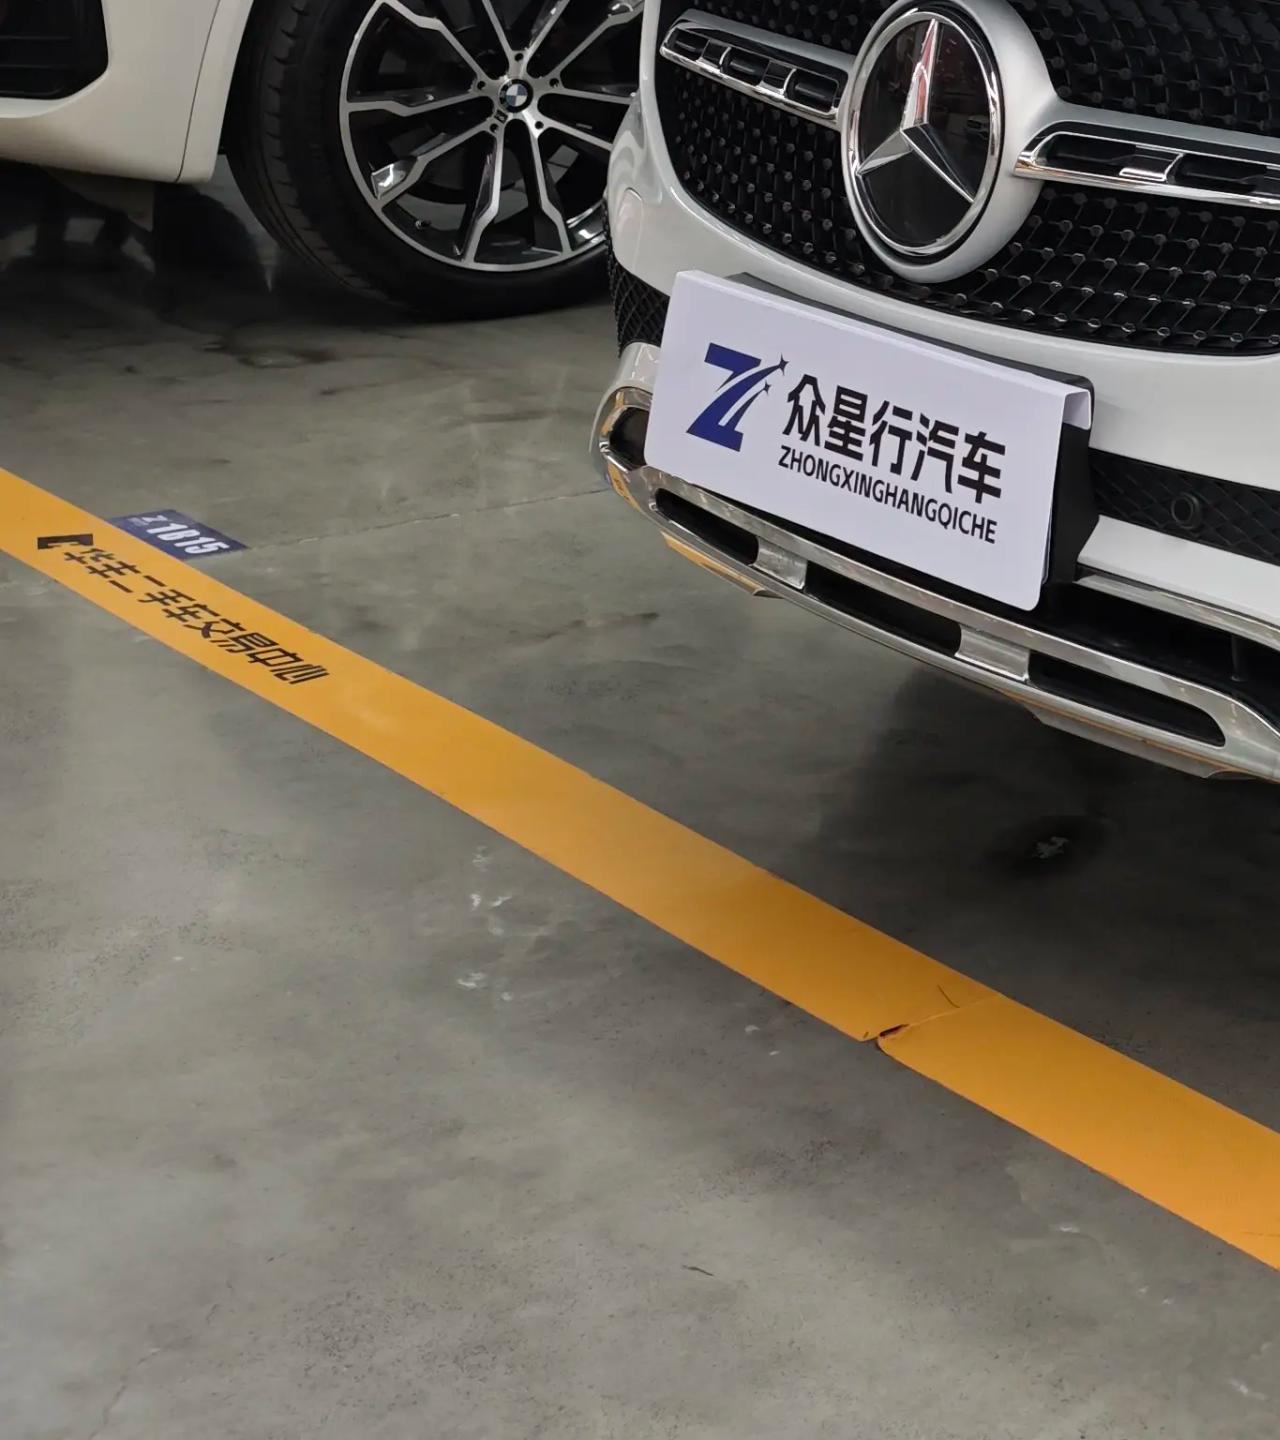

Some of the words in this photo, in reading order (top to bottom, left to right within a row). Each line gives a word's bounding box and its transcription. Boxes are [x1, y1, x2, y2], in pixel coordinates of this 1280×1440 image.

[778, 445, 999, 544] ZHONGXINGHANGQICHE
[782, 374, 1006, 504] 众星行汽车
